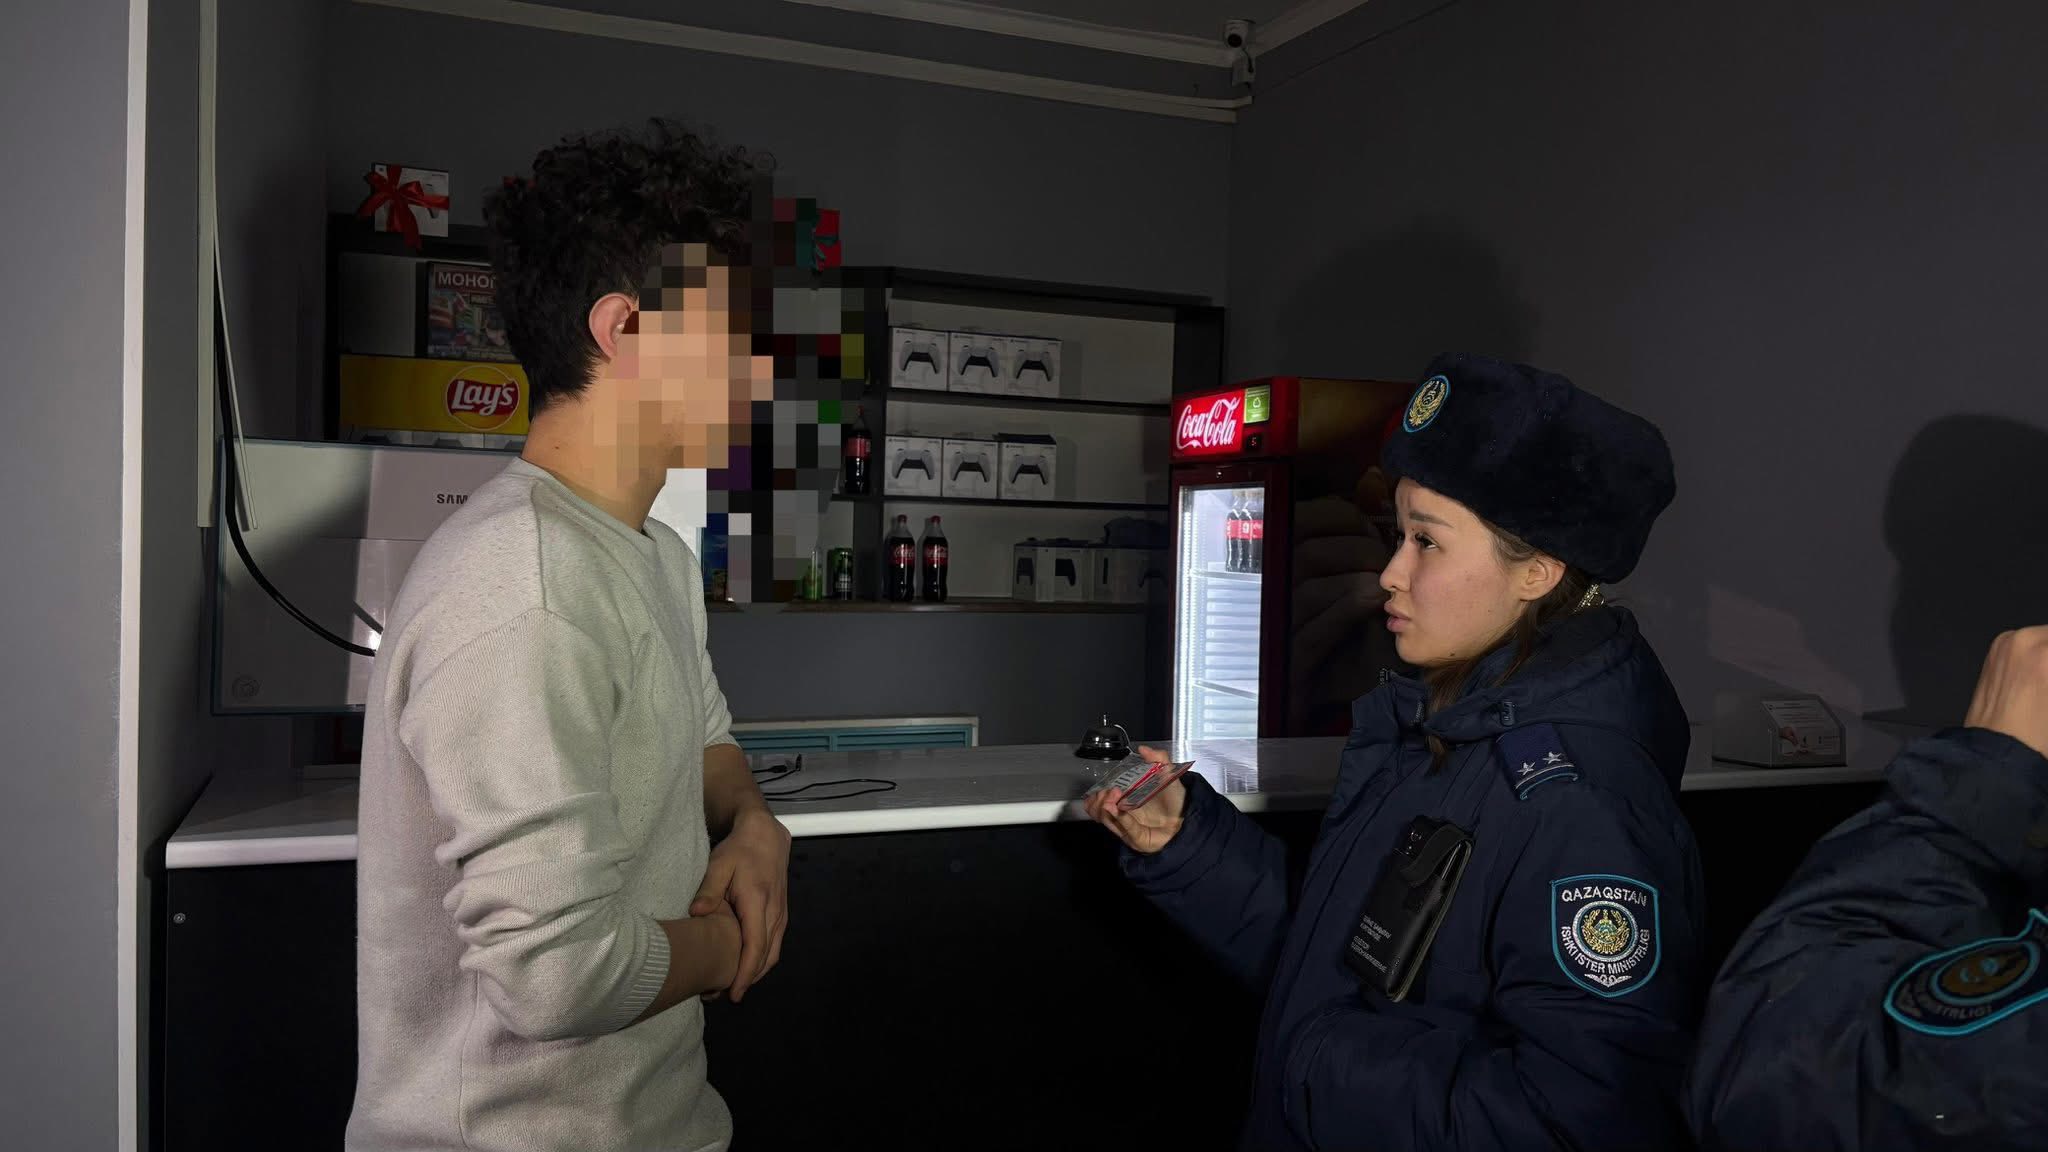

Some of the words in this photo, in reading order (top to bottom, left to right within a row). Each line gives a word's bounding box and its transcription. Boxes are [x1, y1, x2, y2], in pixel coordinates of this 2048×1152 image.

[451, 380, 515, 416] Lay's
[1177, 397, 1241, 450] Coca-Cola
[1561, 886, 1647, 907] QAZAQSTAN
[1561, 926, 1579, 957] ISHKI
[1574, 951, 1606, 974] ISTER
